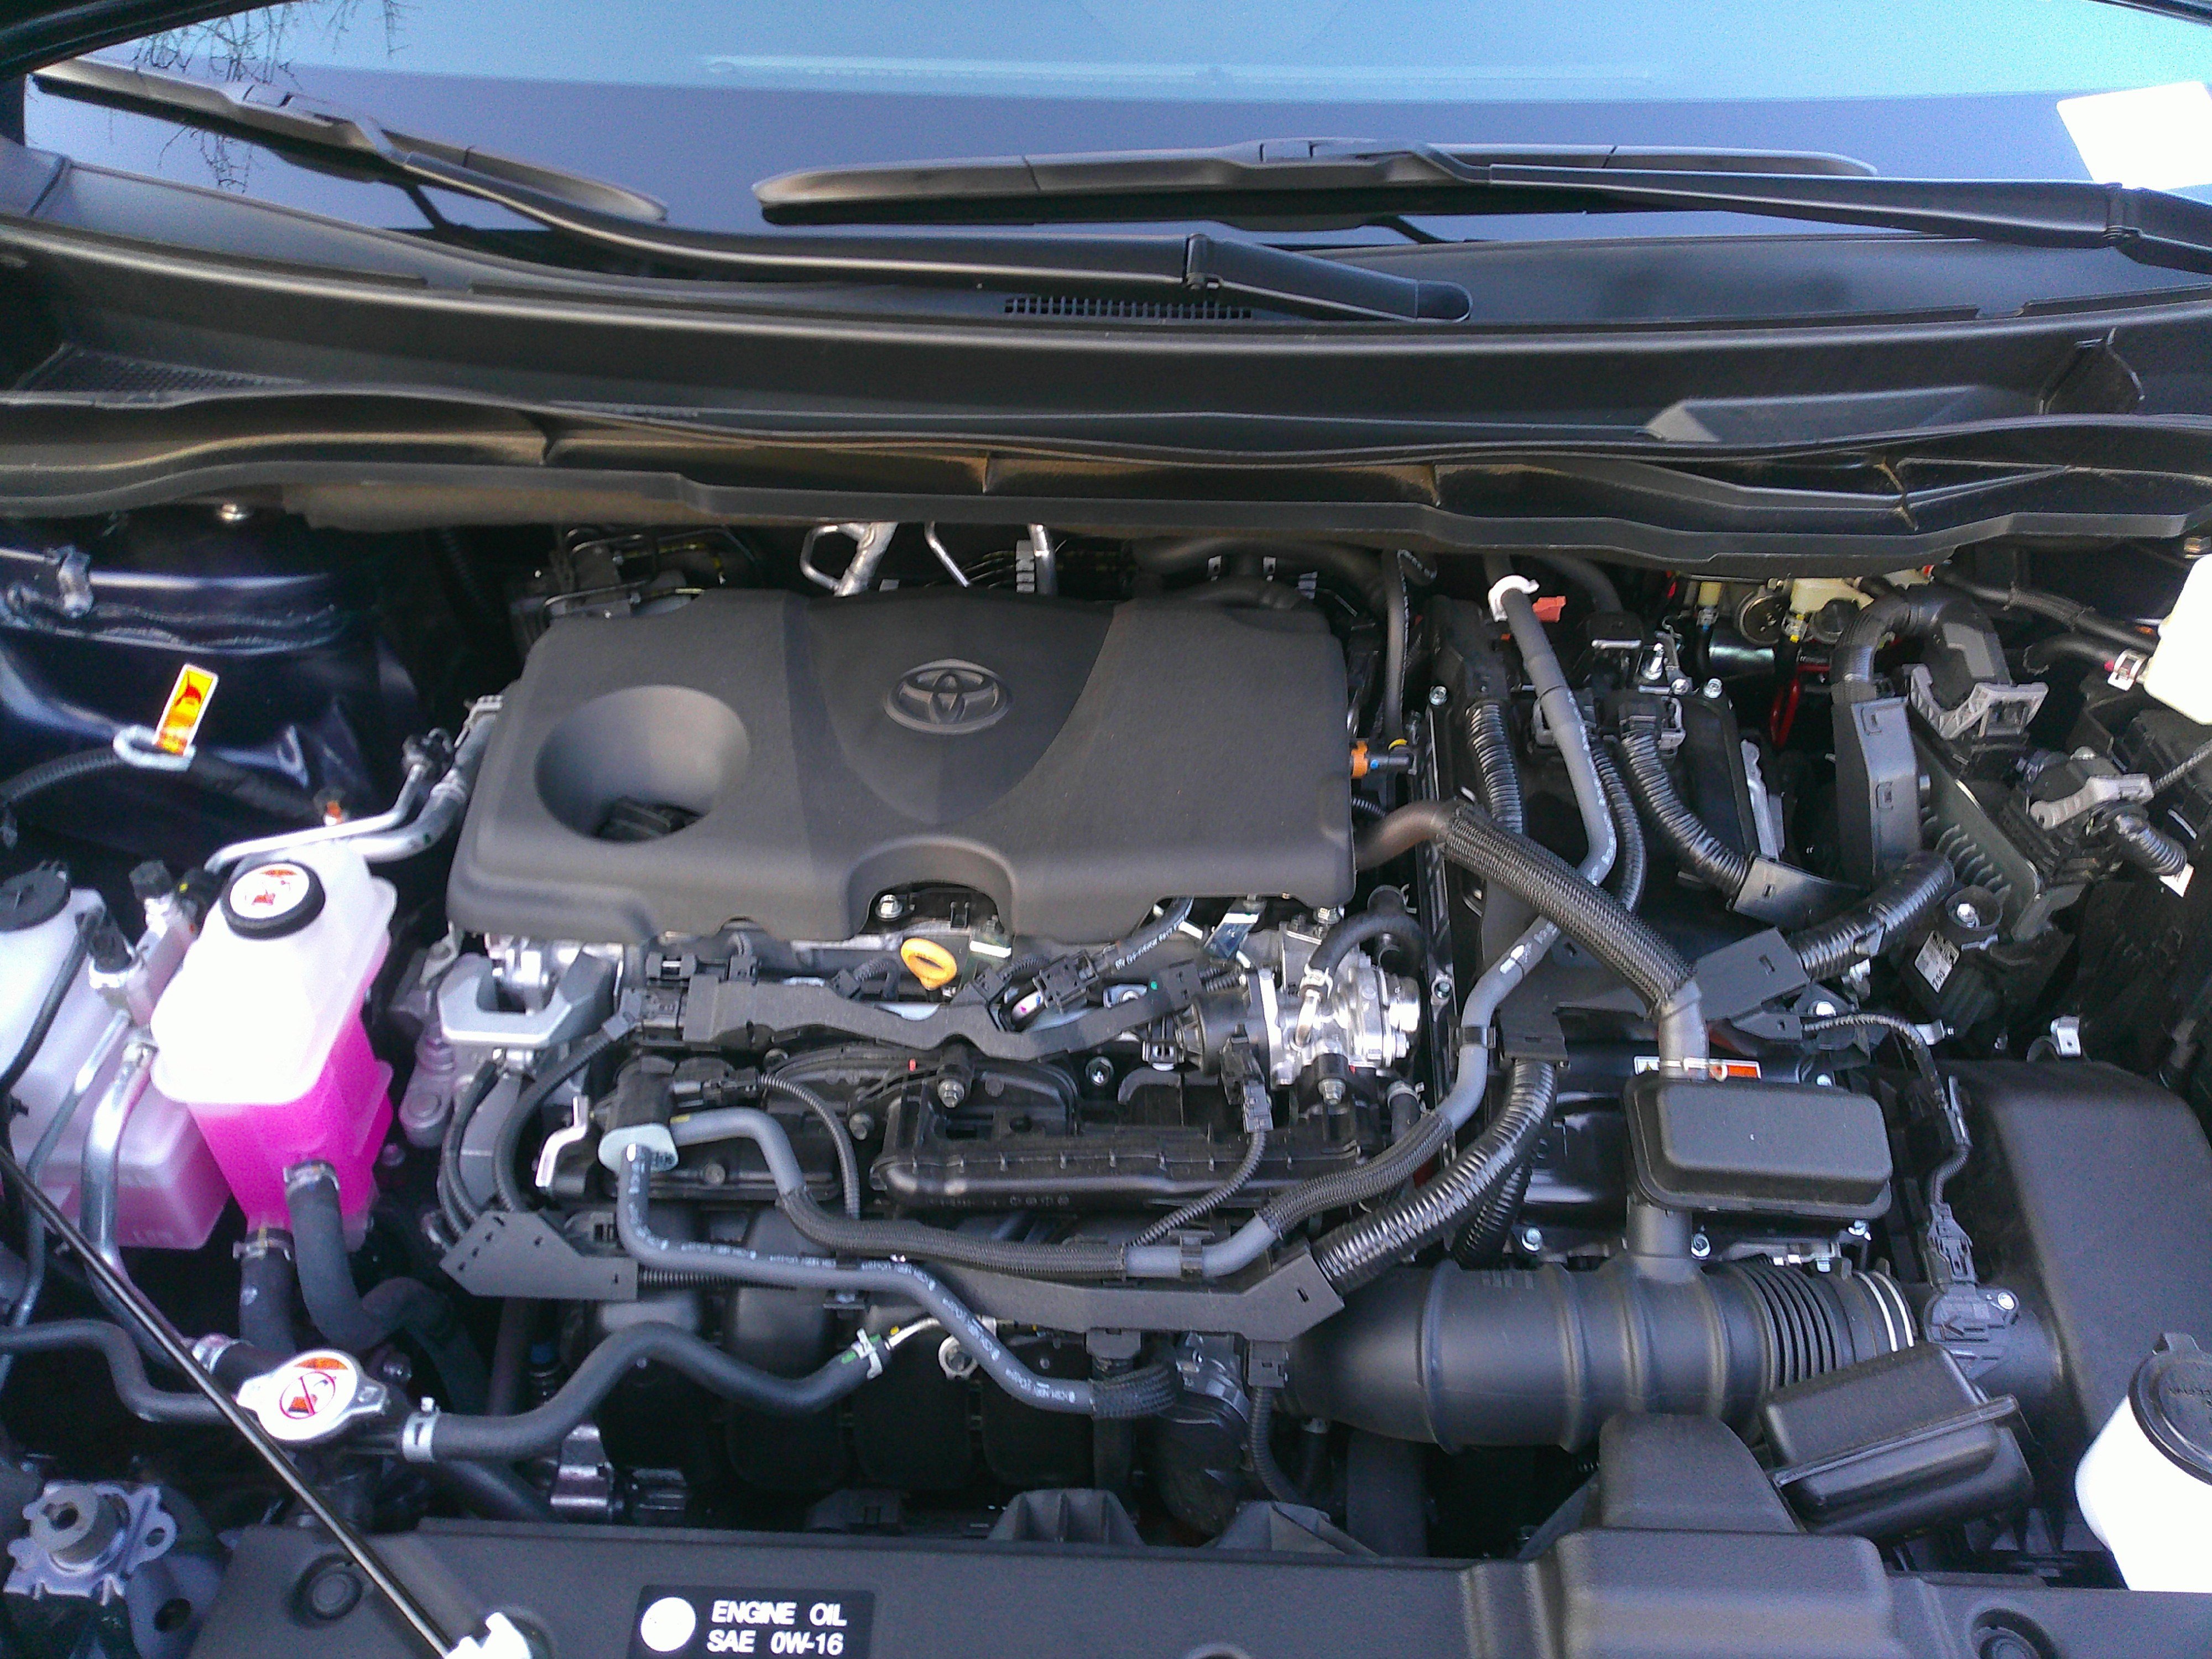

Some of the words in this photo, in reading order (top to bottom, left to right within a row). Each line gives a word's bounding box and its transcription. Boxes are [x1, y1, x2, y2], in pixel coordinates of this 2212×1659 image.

[711, 1600, 797, 1625] ENGINE
[809, 1603, 848, 1626] OIL
[706, 1629, 757, 1653] SAE
[770, 1631, 844, 1656] 0W-16
